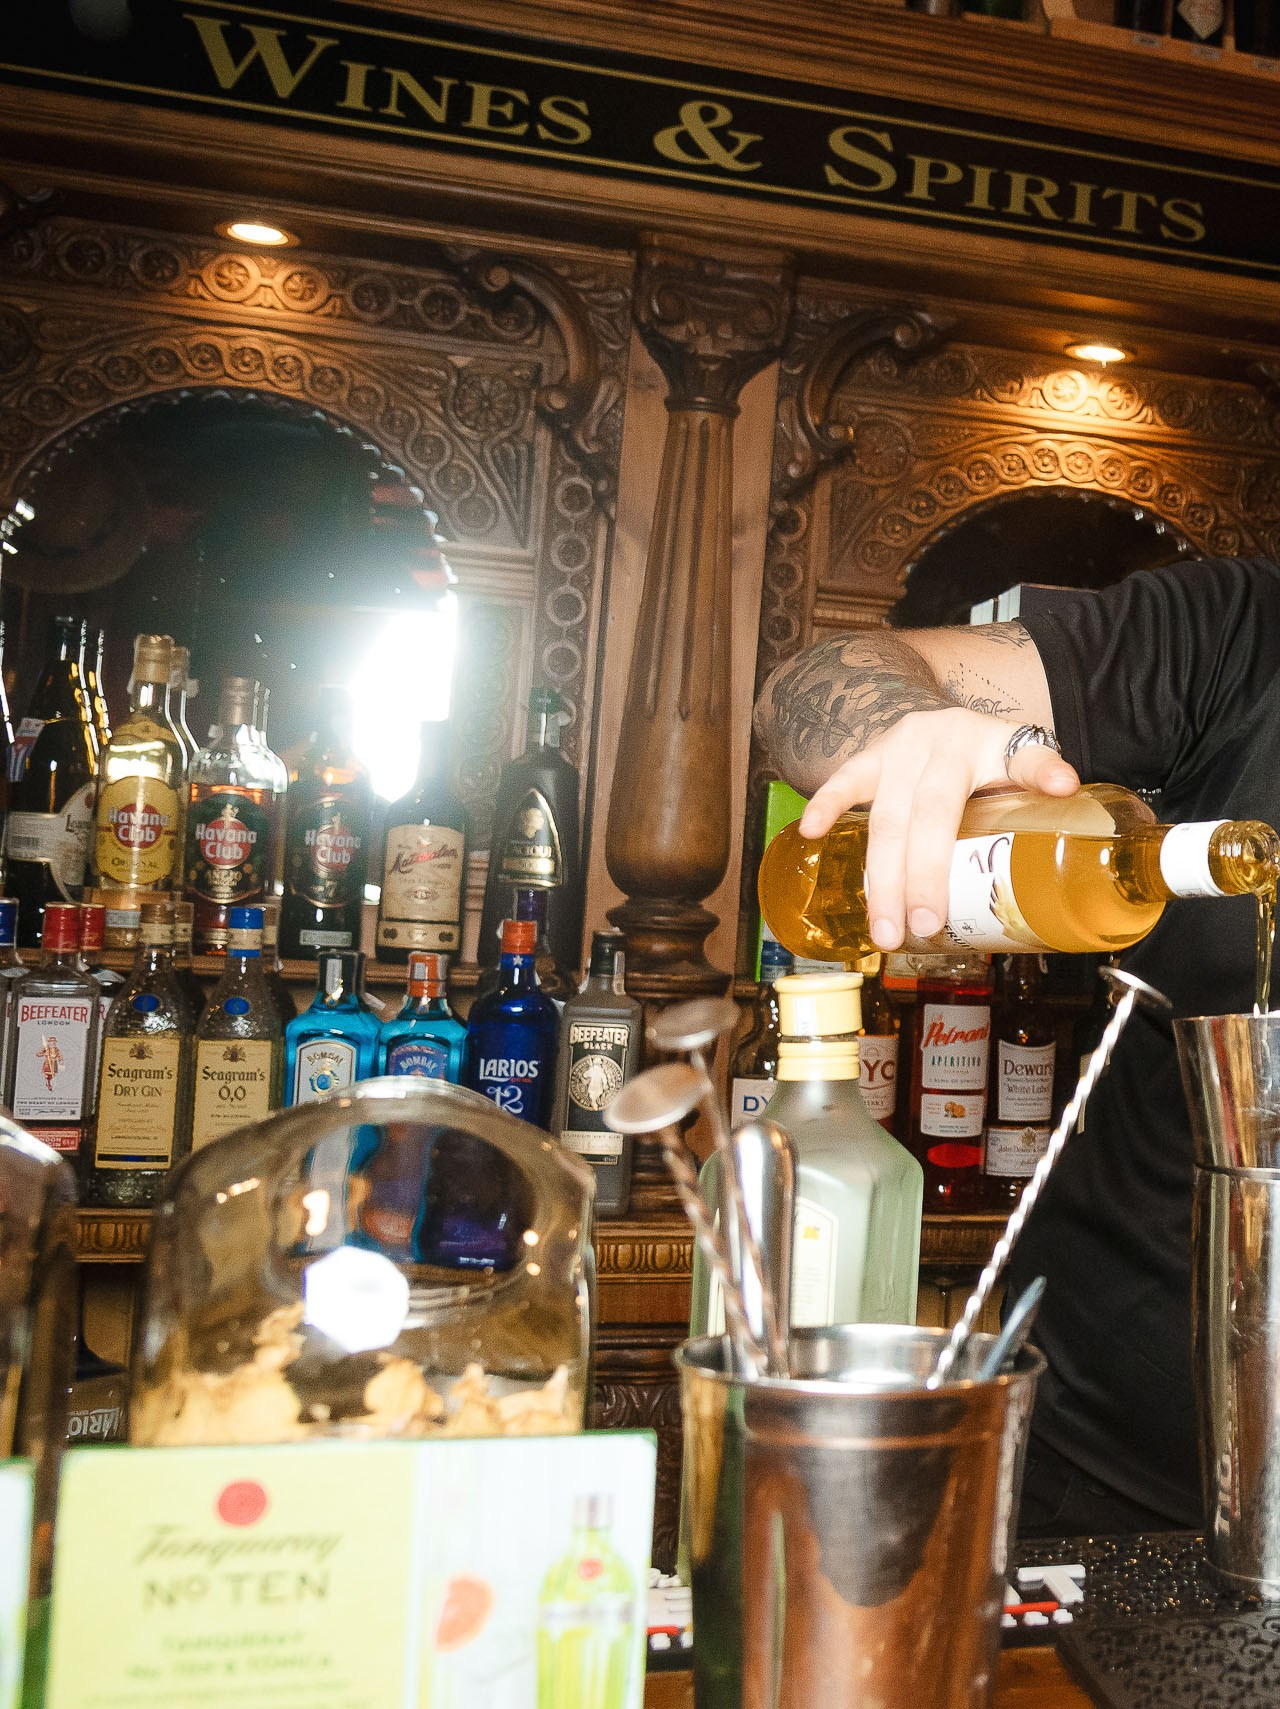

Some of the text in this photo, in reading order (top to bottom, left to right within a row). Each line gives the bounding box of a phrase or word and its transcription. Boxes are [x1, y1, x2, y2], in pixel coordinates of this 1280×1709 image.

[653, 101, 763, 171] &
[109, 806, 170, 827] Havana
[118, 825, 157, 844] Club
[195, 823, 258, 844] Havana
[304, 829, 362, 849] Havana
[205, 841, 244, 861] Club
[316, 845, 351, 865] Club
[21, 1004, 88, 1024] BEEFEATER
[570, 1026, 630, 1048] BEEFEATER
[583, 1042, 614, 1051] BLACK
[306, 1051, 345, 1067] BOMBAY
[400, 1055, 438, 1074] BOMBAY
[107, 1063, 173, 1082] Seagram's
[202, 1065, 266, 1083] Seagram's
[479, 1057, 540, 1083] LARIOS
[113, 1084, 163, 1098] DRY GIN
[218, 1085, 247, 1103] 0,0
[486, 1085, 524, 1114] 12
[223, 1568, 331, 1606] TEN
